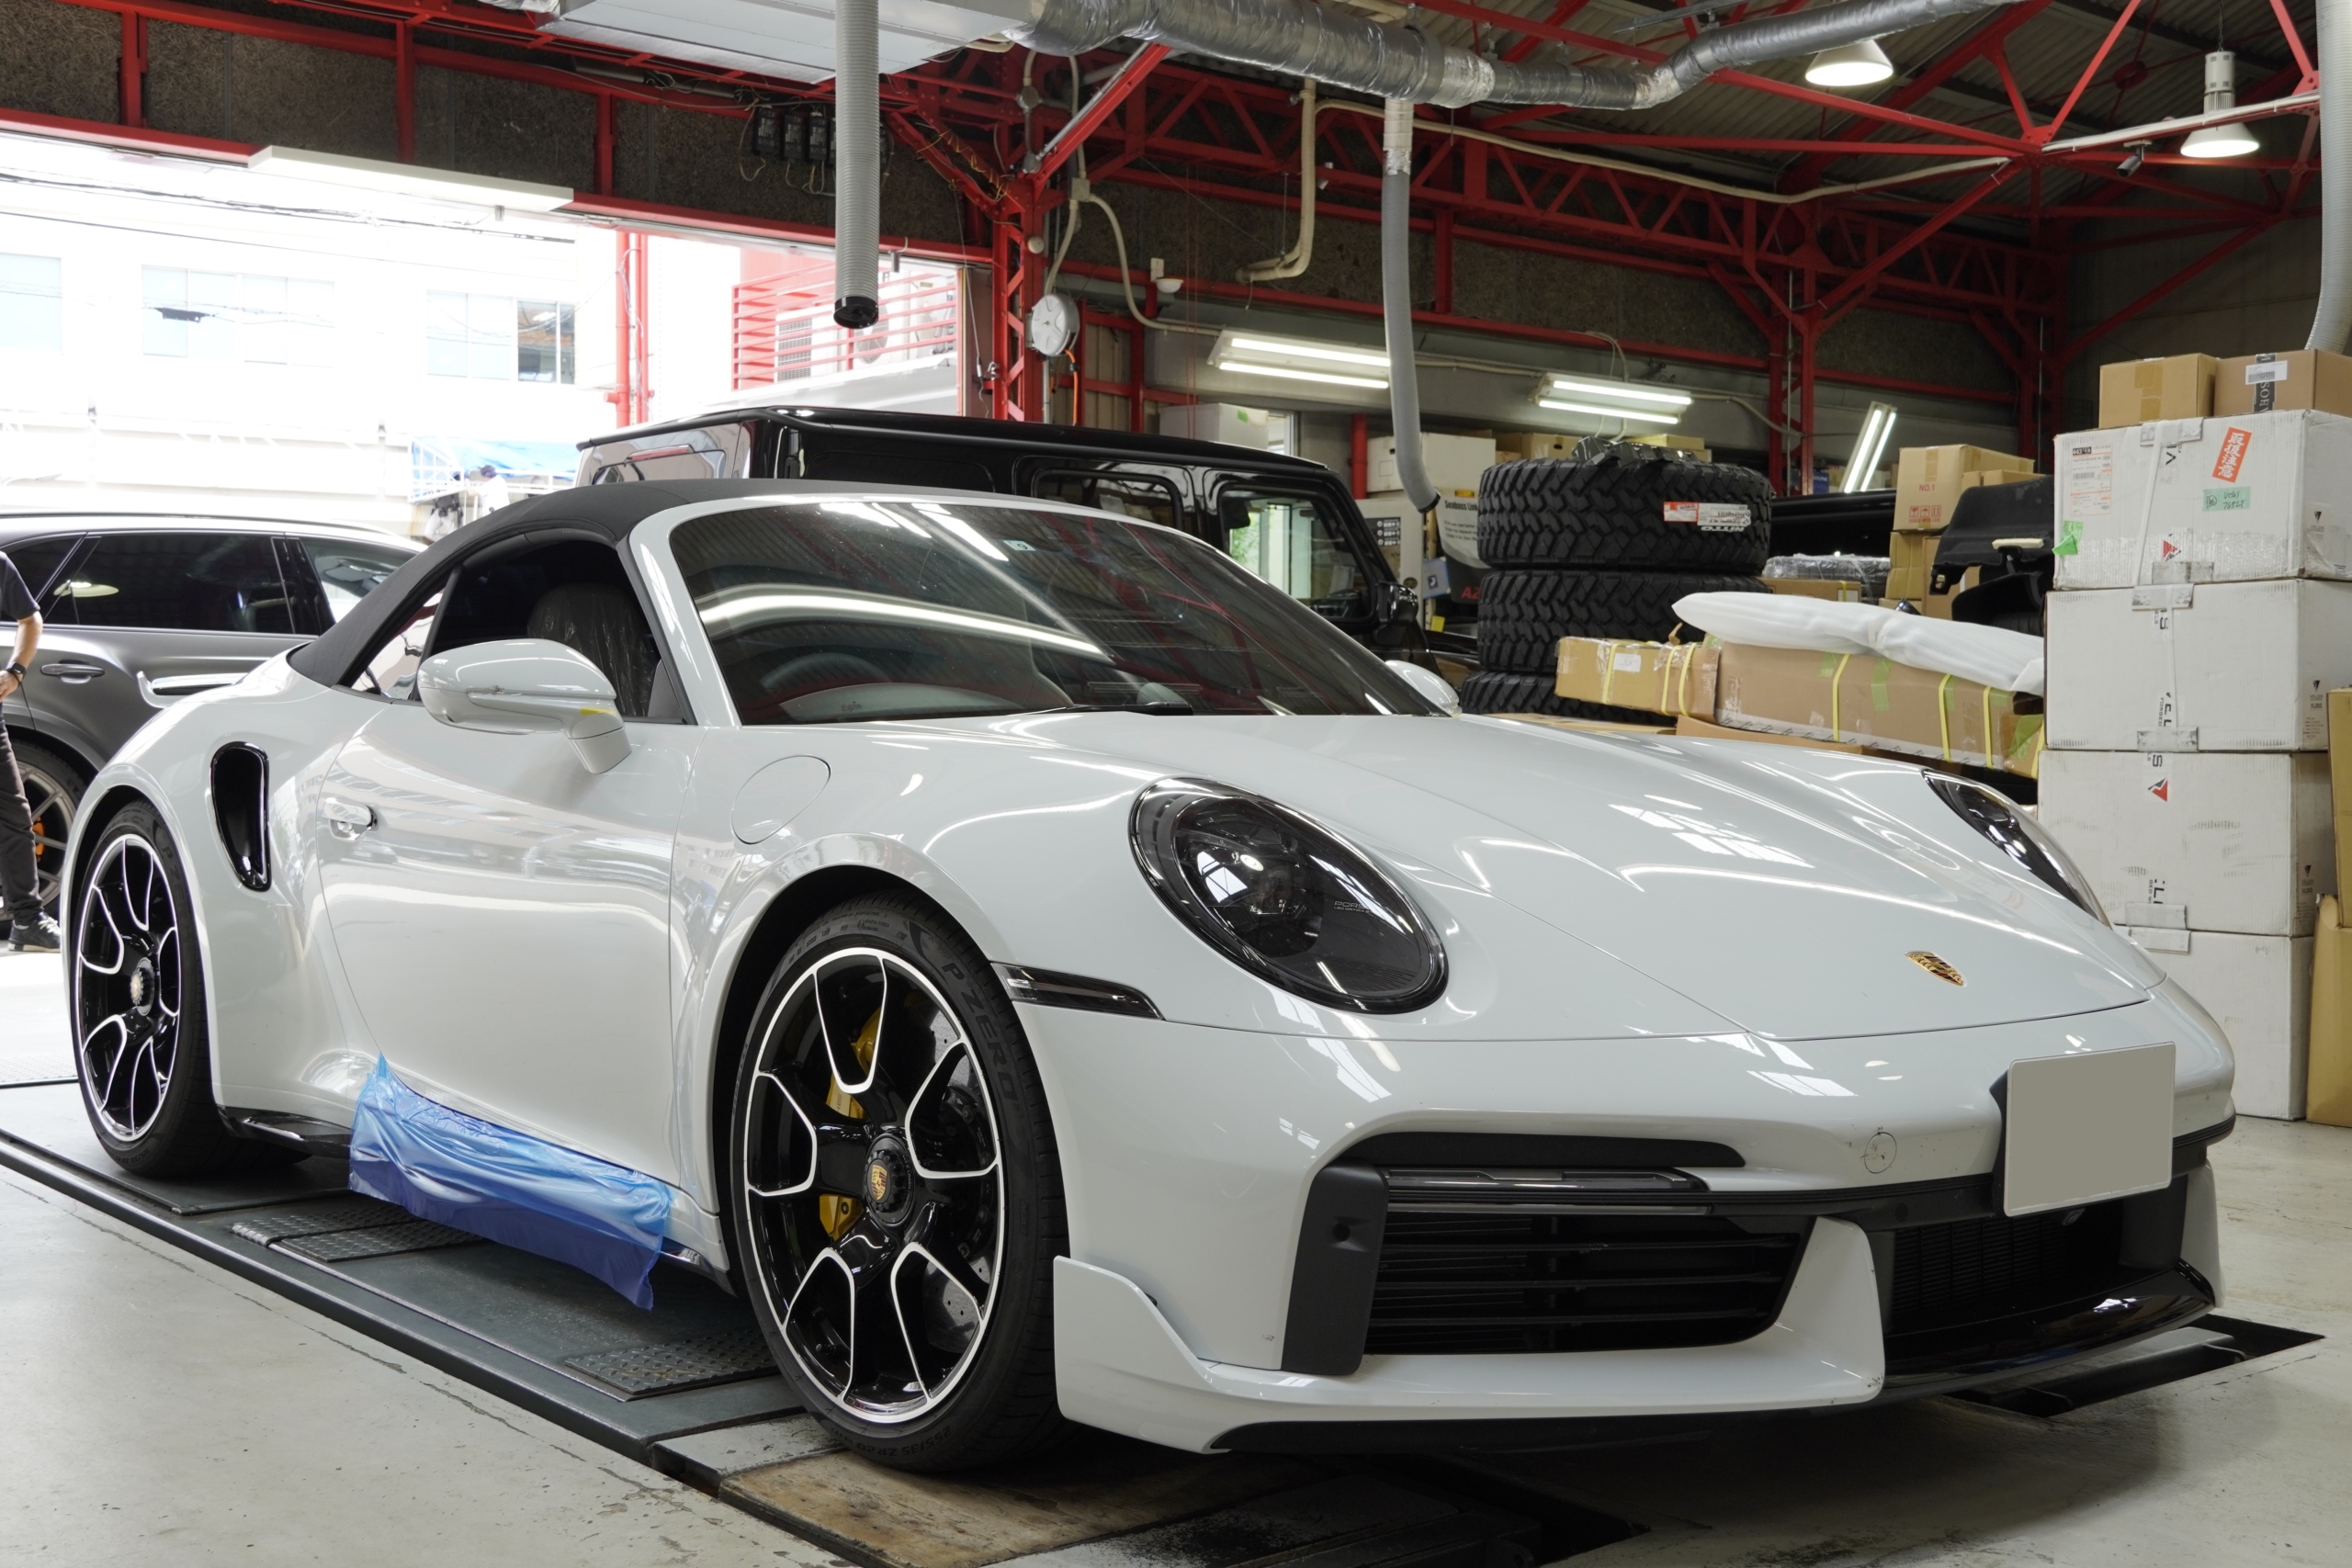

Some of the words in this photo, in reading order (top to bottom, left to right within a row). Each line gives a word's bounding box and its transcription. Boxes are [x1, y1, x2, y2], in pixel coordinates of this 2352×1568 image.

[2218, 432, 2245, 479] 取扱注意
[1444, 500, 1467, 511] Seabass
